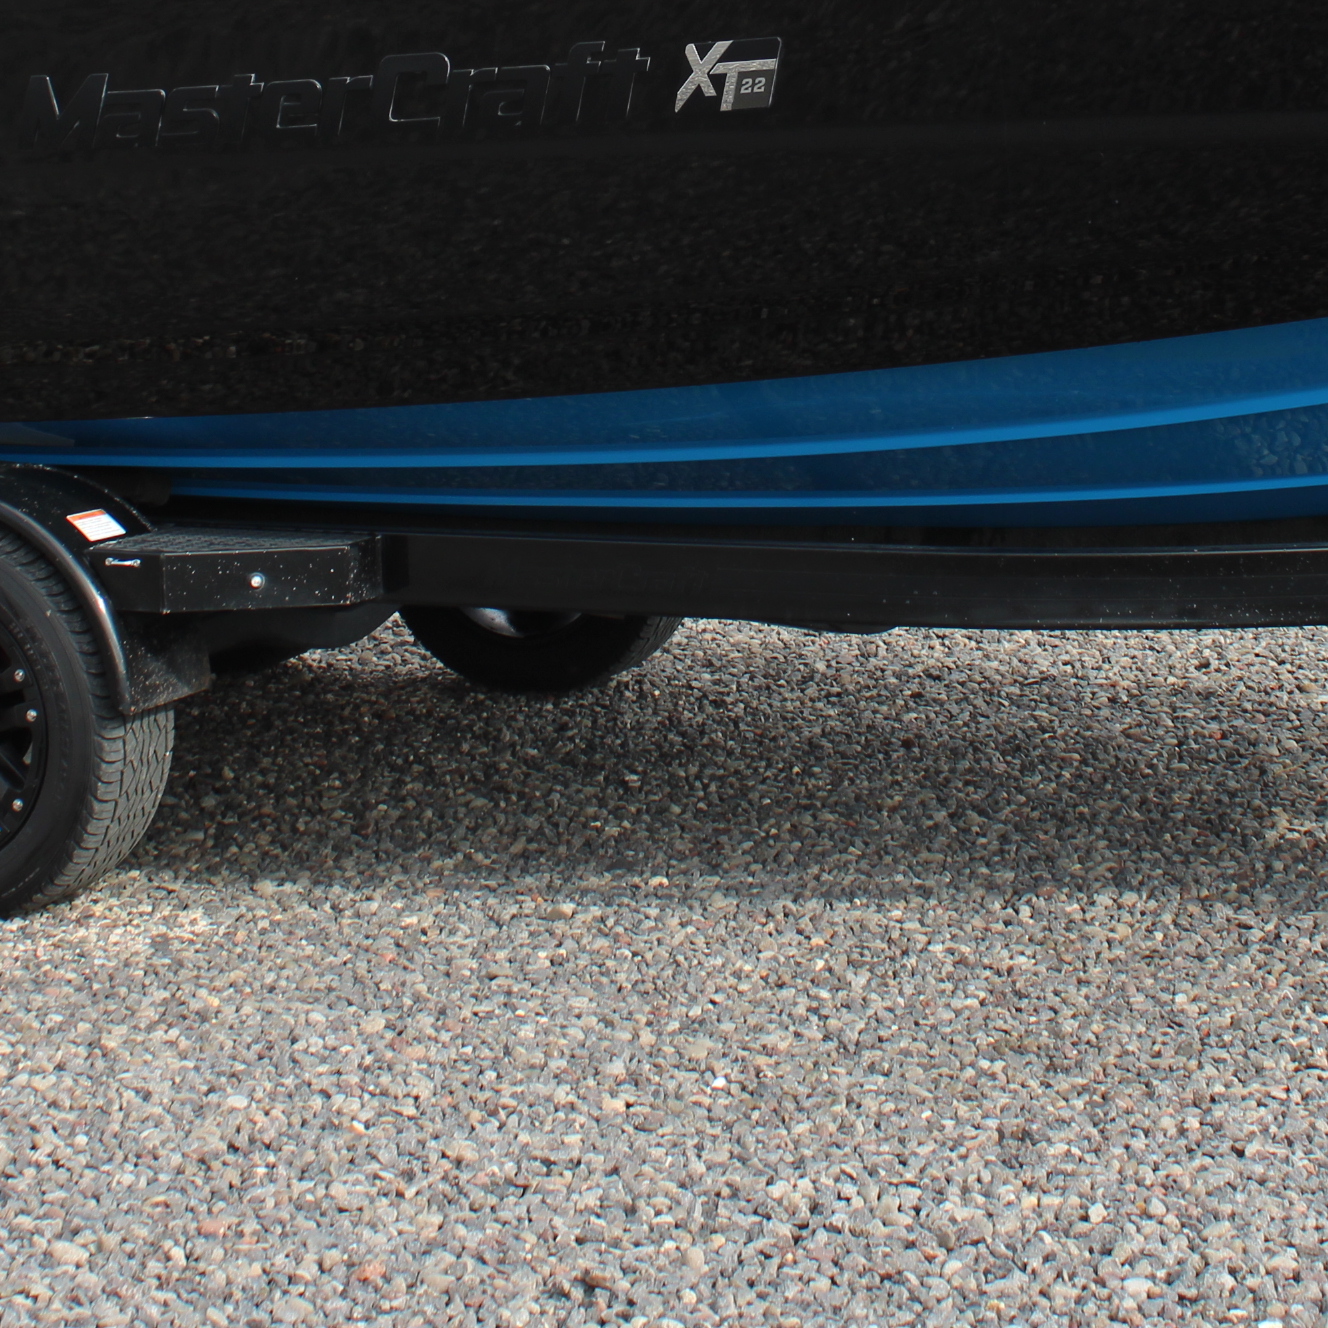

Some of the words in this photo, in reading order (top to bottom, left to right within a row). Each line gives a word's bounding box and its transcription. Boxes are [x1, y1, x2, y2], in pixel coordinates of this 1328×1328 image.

[17, 40, 651, 151] MasterCraft
[674, 39, 778, 113] XT
[740, 77, 766, 93] 22
